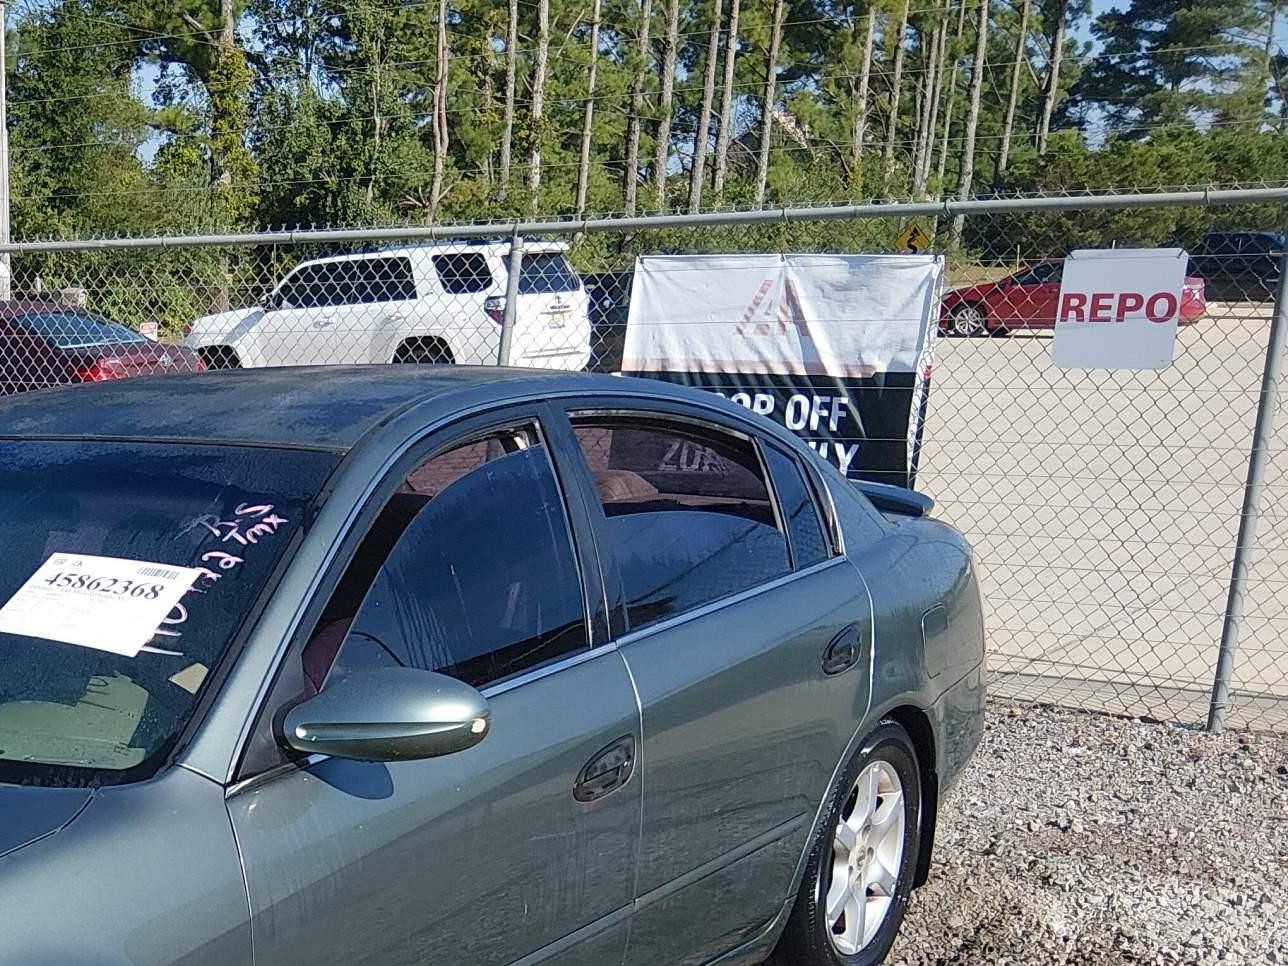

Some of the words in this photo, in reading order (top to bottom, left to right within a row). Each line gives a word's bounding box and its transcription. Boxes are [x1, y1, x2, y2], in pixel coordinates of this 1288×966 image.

[1059, 291, 1178, 324] REPO
[785, 394, 849, 432] OFF
[44, 571, 165, 601] 45862368
